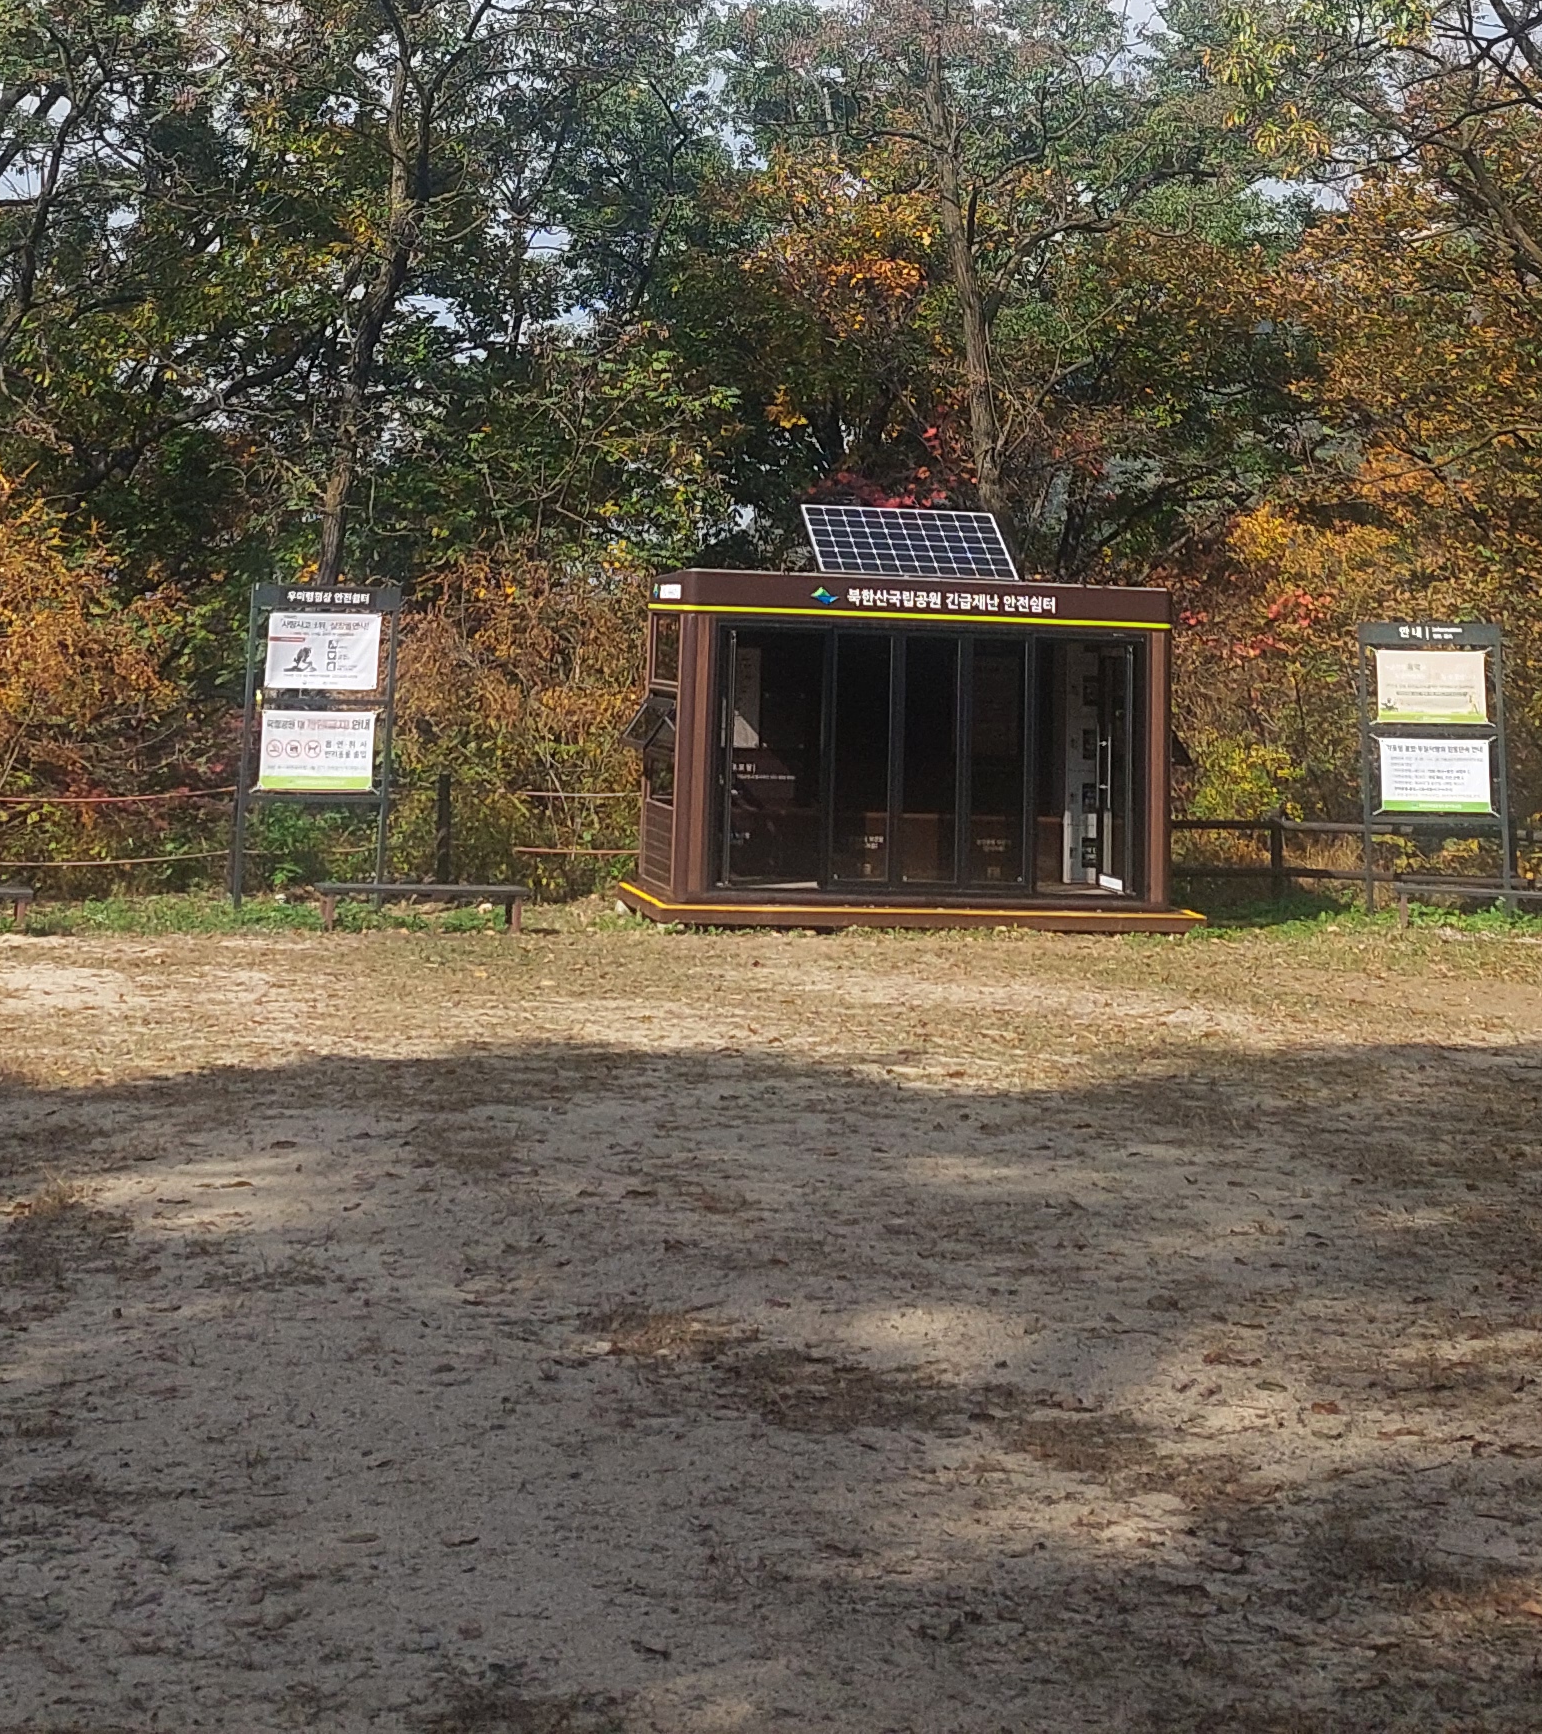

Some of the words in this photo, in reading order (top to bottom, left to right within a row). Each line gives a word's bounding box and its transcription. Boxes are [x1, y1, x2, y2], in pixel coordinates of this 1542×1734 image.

[847, 588, 942, 609] 북한산국립공원
[946, 592, 1000, 611] 긴급재난
[1003, 595, 1056, 614] 안전쉼터
[1399, 625, 1422, 639] 안내
